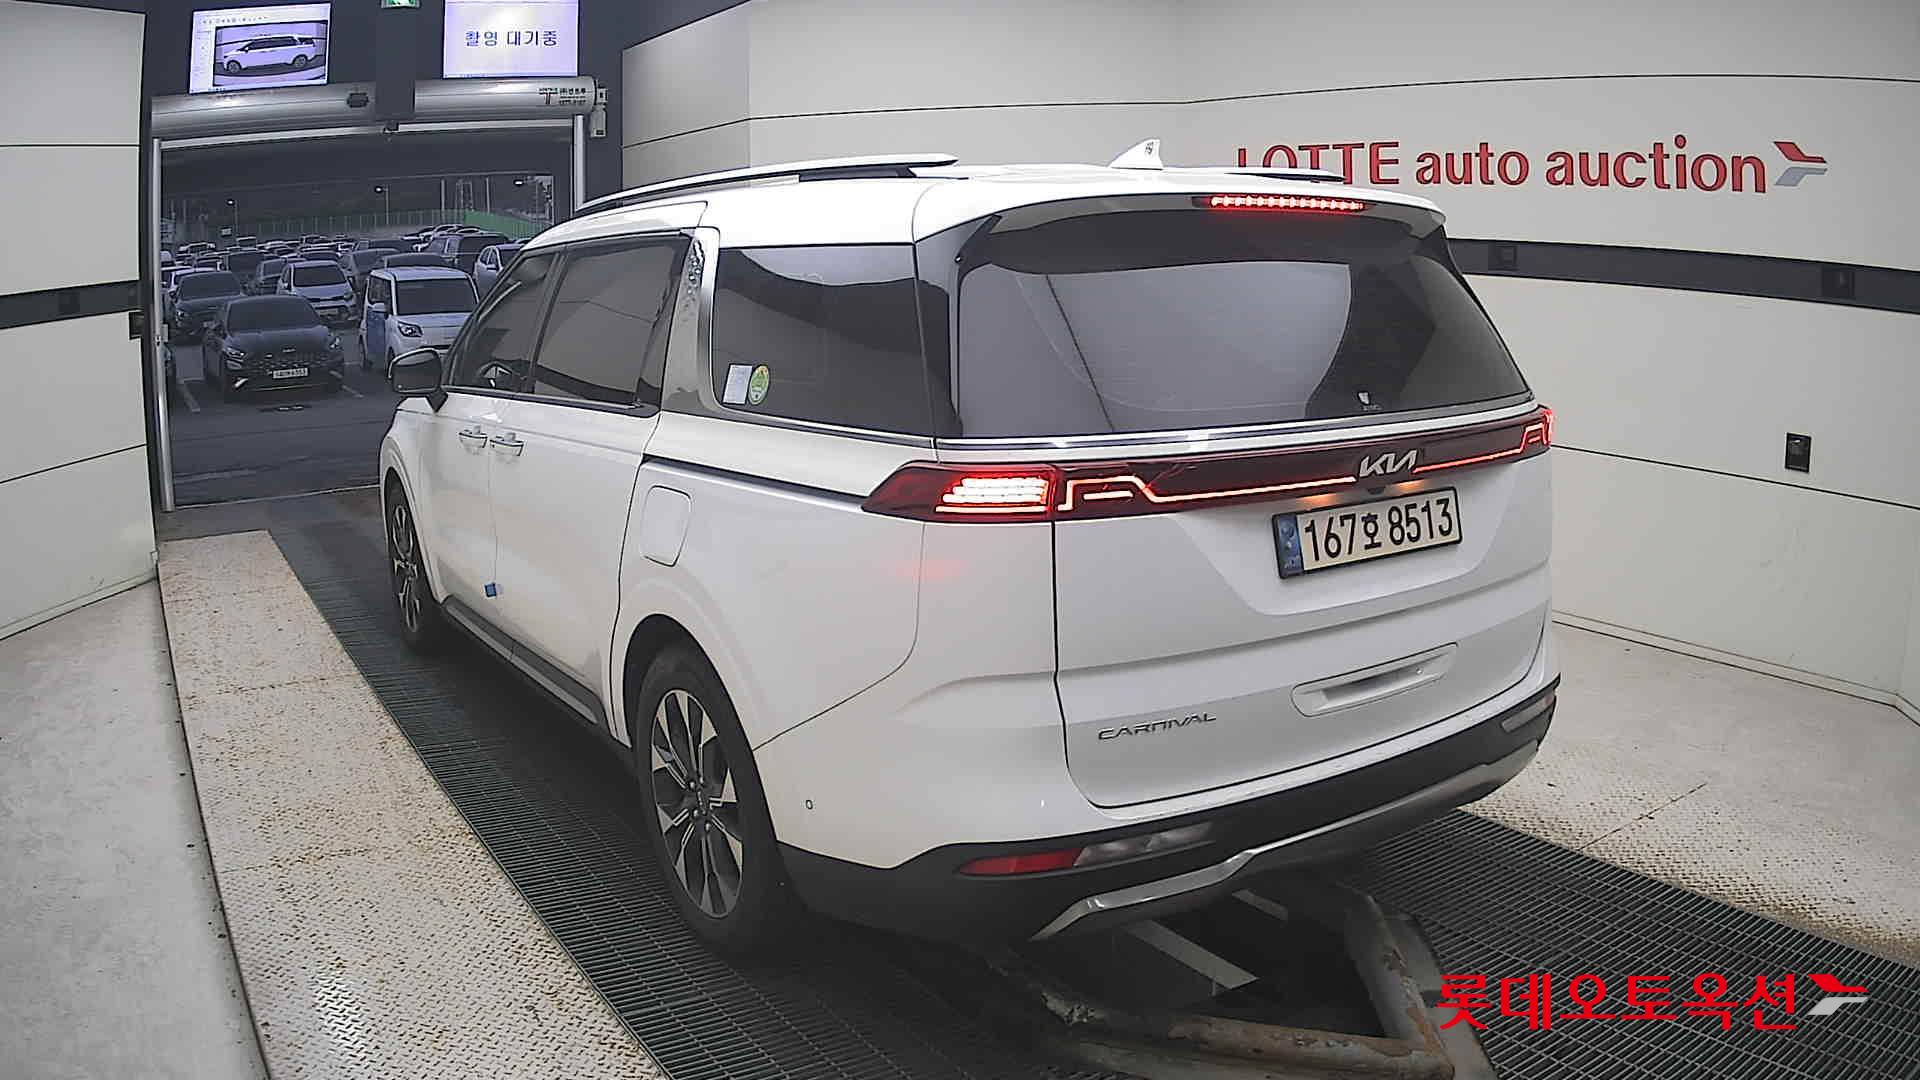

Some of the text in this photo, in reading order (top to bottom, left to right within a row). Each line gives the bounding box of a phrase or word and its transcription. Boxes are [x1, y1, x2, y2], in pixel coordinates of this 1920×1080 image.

[507, 31, 557, 46] 대기중
[1414, 142, 1530, 185] auto
[1545, 135, 1767, 193] auction
[1359, 449, 1418, 477] KIA
[1304, 498, 1452, 561] 167호 8513
[1098, 712, 1217, 740] CARNIVAL
